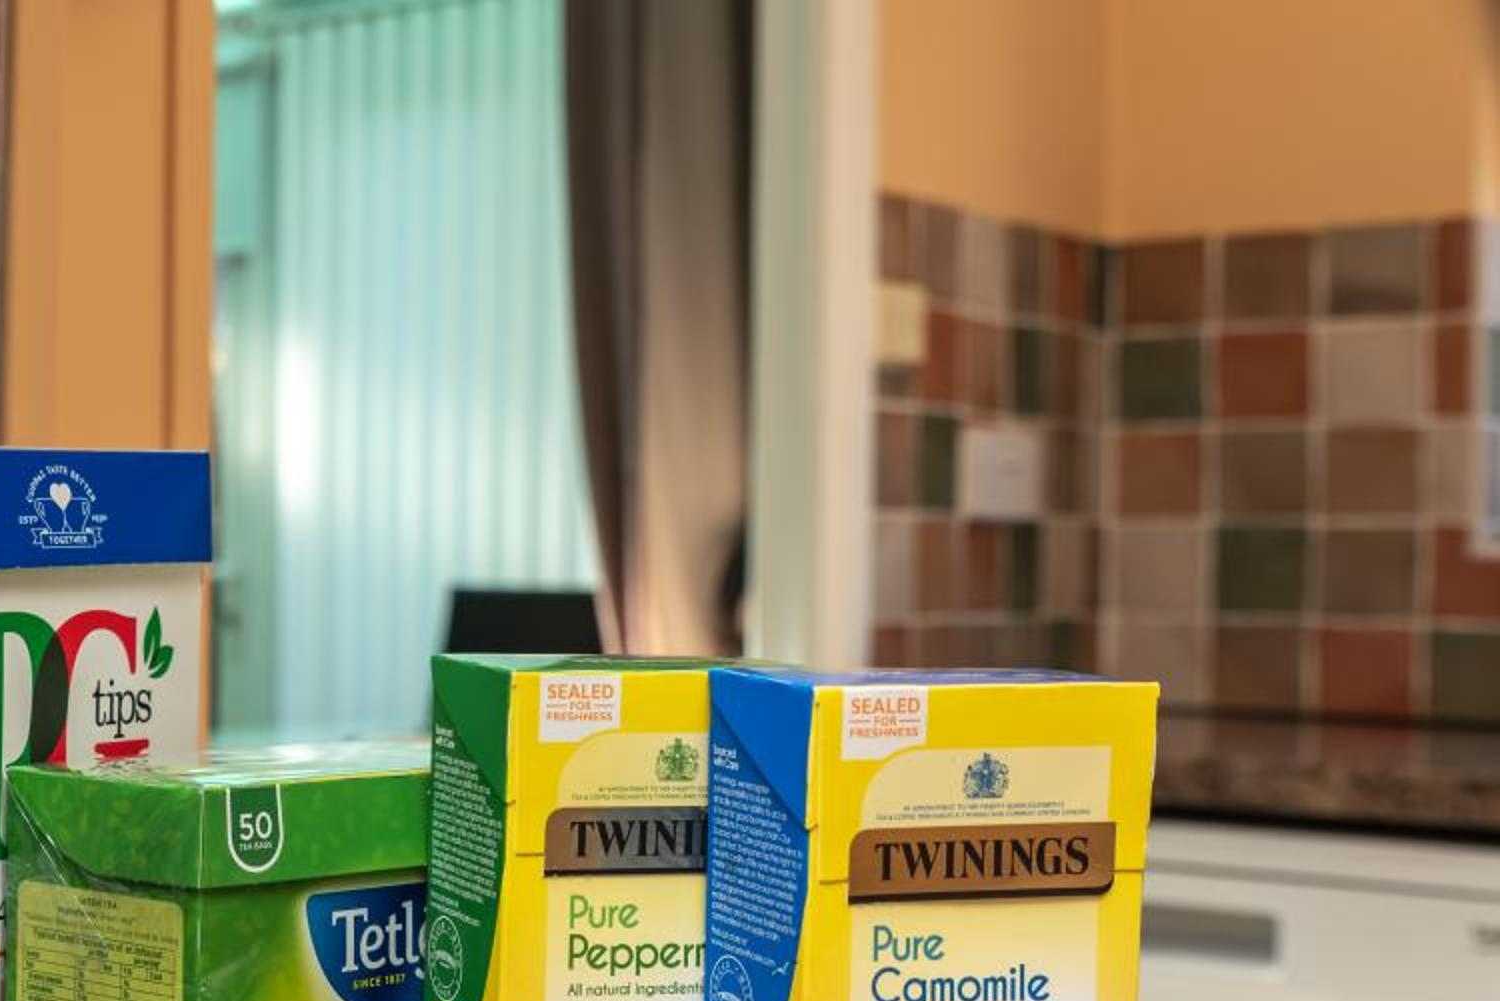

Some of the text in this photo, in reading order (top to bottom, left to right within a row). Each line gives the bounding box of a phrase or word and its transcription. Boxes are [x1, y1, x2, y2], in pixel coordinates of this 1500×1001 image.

[547, 683, 614, 699] SEALED
[92, 679, 152, 739] tips
[569, 701, 591, 710] FOR
[851, 698, 921, 714] SEALED
[546, 711, 613, 721] FRESHNESS
[874, 716, 897, 726] FOR
[850, 726, 918, 738] FRESHNESS
[239, 811, 273, 841] 50
[239, 841, 273, 851] TEA BAGS
[875, 836, 1089, 881] TWININGS
[569, 895, 639, 928] Pure
[873, 925, 944, 961] Pure
[353, 977, 381, 989] SINCE
[568, 984, 582, 996] All
[586, 982, 631, 996] natural
